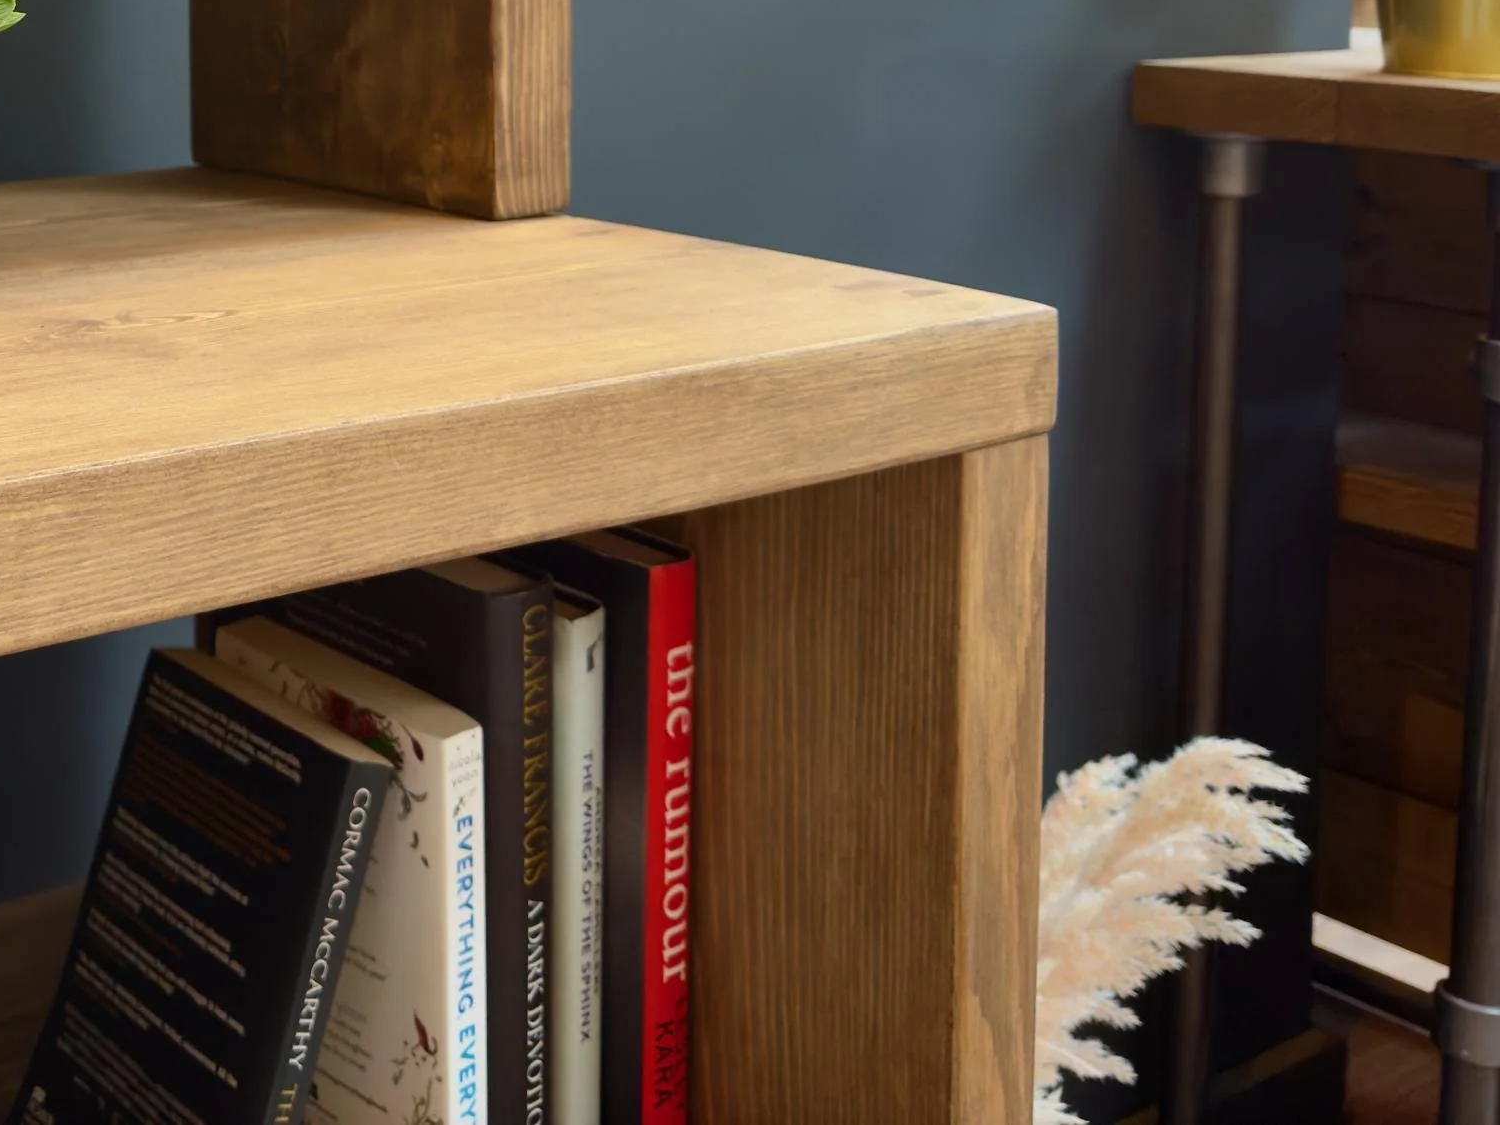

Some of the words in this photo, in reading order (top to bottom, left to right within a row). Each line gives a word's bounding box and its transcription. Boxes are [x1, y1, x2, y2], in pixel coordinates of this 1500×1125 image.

[523, 604, 548, 724] CLARE
[665, 641, 694, 739] the
[523, 733, 549, 887] FRANCIS
[583, 749, 594, 793] THE
[328, 787, 371, 912] CORMAC
[581, 797, 593, 873] WINGS
[662, 759, 690, 984] rumour
[527, 899, 545, 920] A
[581, 879, 592, 906] OF
[581, 915, 592, 956] THE
[527, 921, 545, 1004] DARK
[580, 963, 592, 1044] SPHINX
[459, 1023, 477, 1125] EVERY
[653, 1019, 675, 1109] KARA
